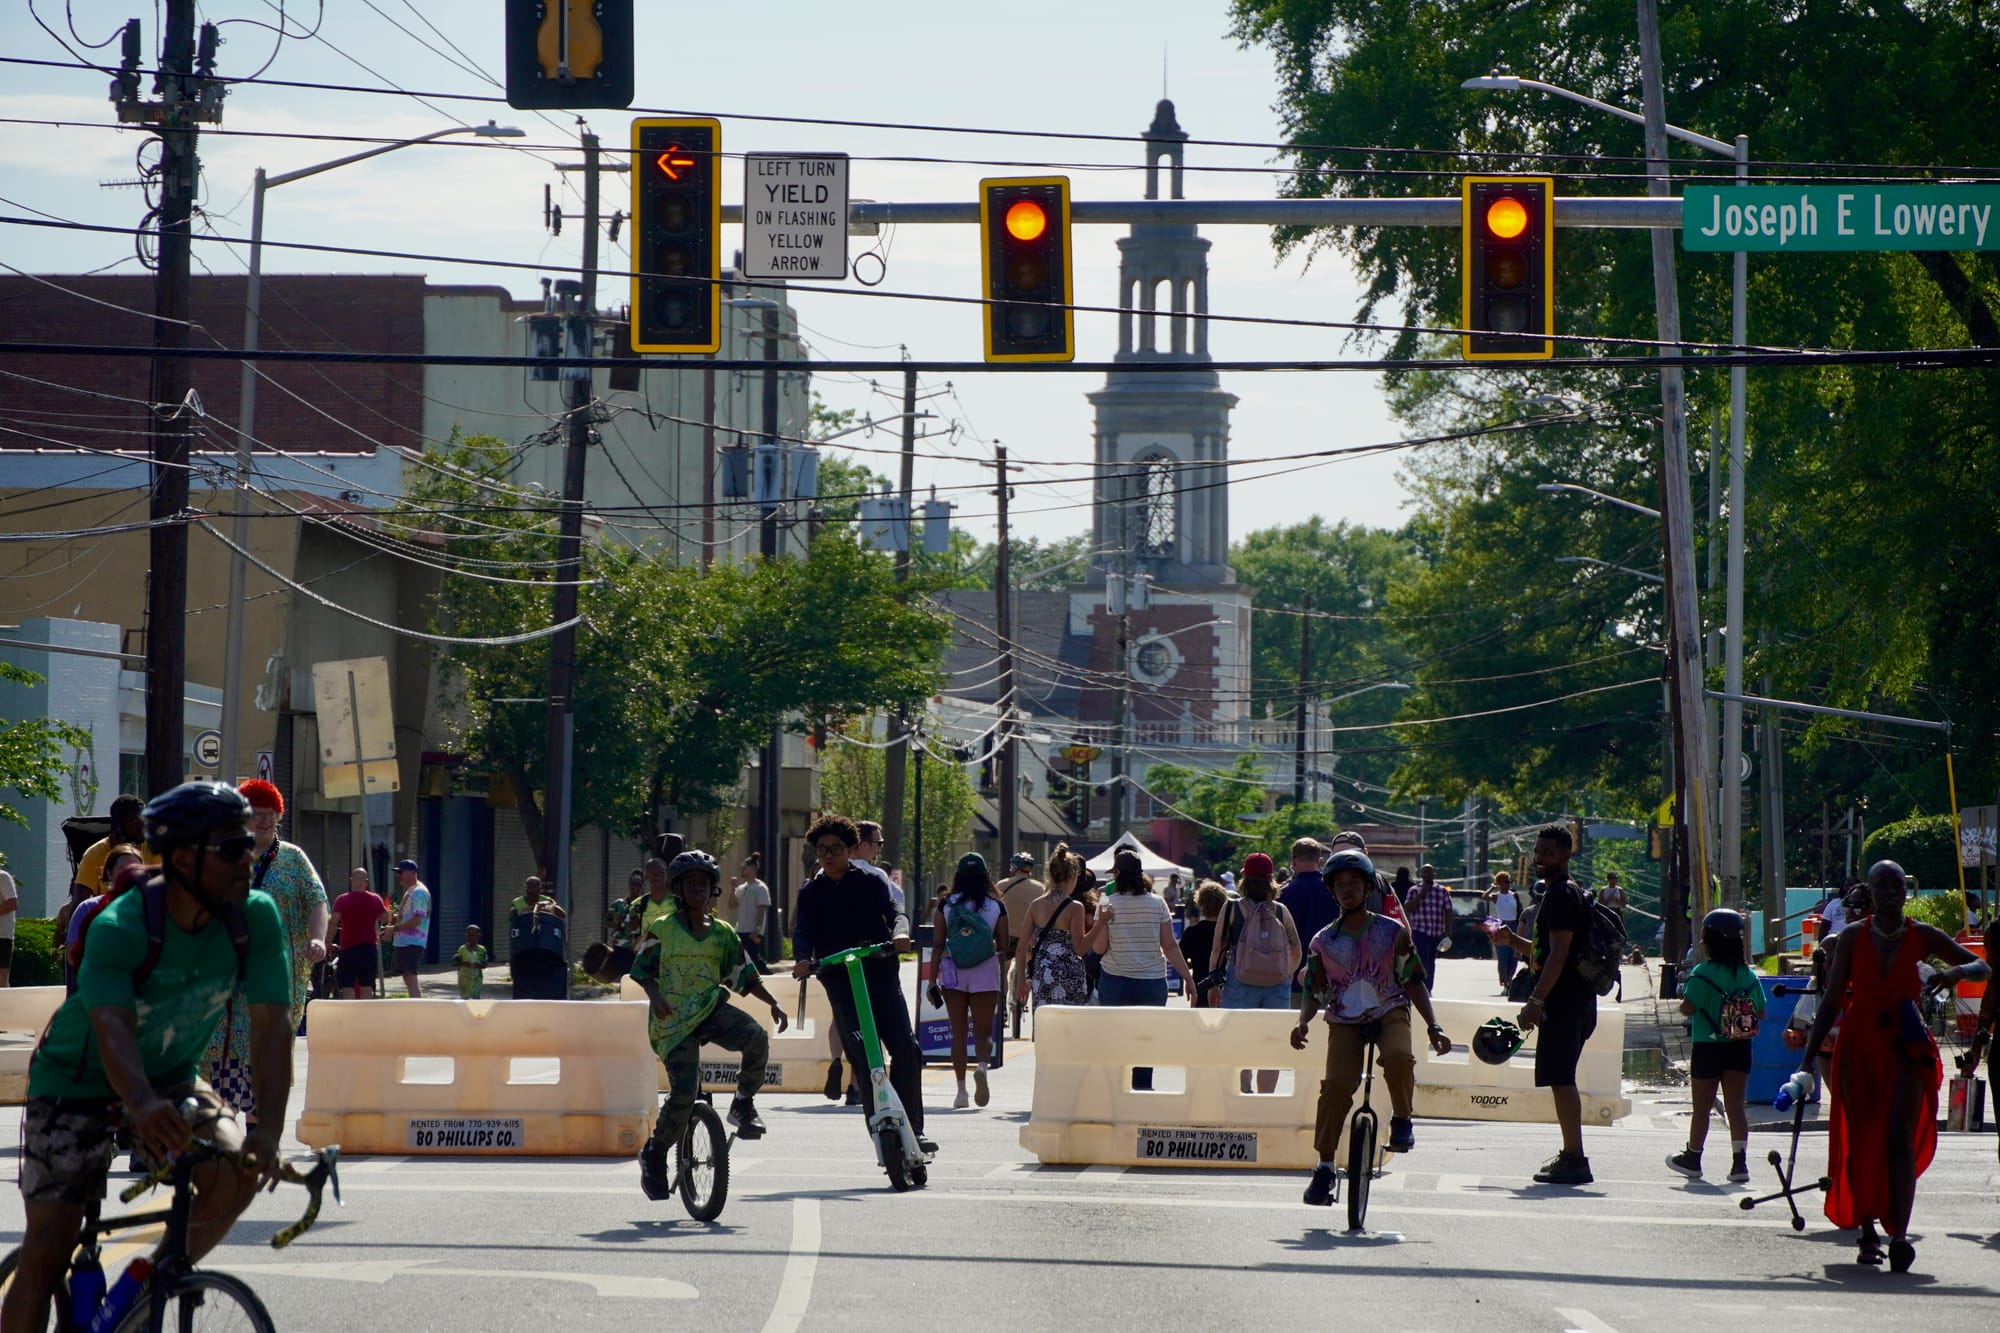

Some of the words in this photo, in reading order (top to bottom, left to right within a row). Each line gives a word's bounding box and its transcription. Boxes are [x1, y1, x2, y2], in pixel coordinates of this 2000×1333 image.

[758, 162, 791, 176] LEFT
[799, 162, 835, 176] TURN
[765, 184, 829, 204] YIELD
[756, 211, 772, 225] ON
[778, 211, 836, 226] FLASHING
[1700, 194, 1818, 246] Joseph
[1837, 194, 1856, 236] E
[1874, 194, 1992, 247] Lowery
[768, 234, 824, 248] YELLOW
[771, 256, 820, 271] ARROW
[1072, 748, 1092, 760] ACE
[927, 1025, 949, 1034] Scan
[933, 1034, 943, 1042] to
[714, 1071, 737, 1083] PHIL
[1471, 1095, 1509, 1105] YODOCK
[411, 1120, 440, 1128] RENTED
[444, 1120, 465, 1128] FROM
[468, 1120, 520, 1128] 770-939-6115
[437, 1130, 494, 1147] PHILLIPS
[496, 1130, 516, 1147] CO.
[1141, 1129, 1172, 1139] RENTED
[1175, 1131, 1197, 1139] FROM
[1168, 1141, 1226, 1159] PHILLIPS
[1229, 1143, 1248, 1160] CO.
